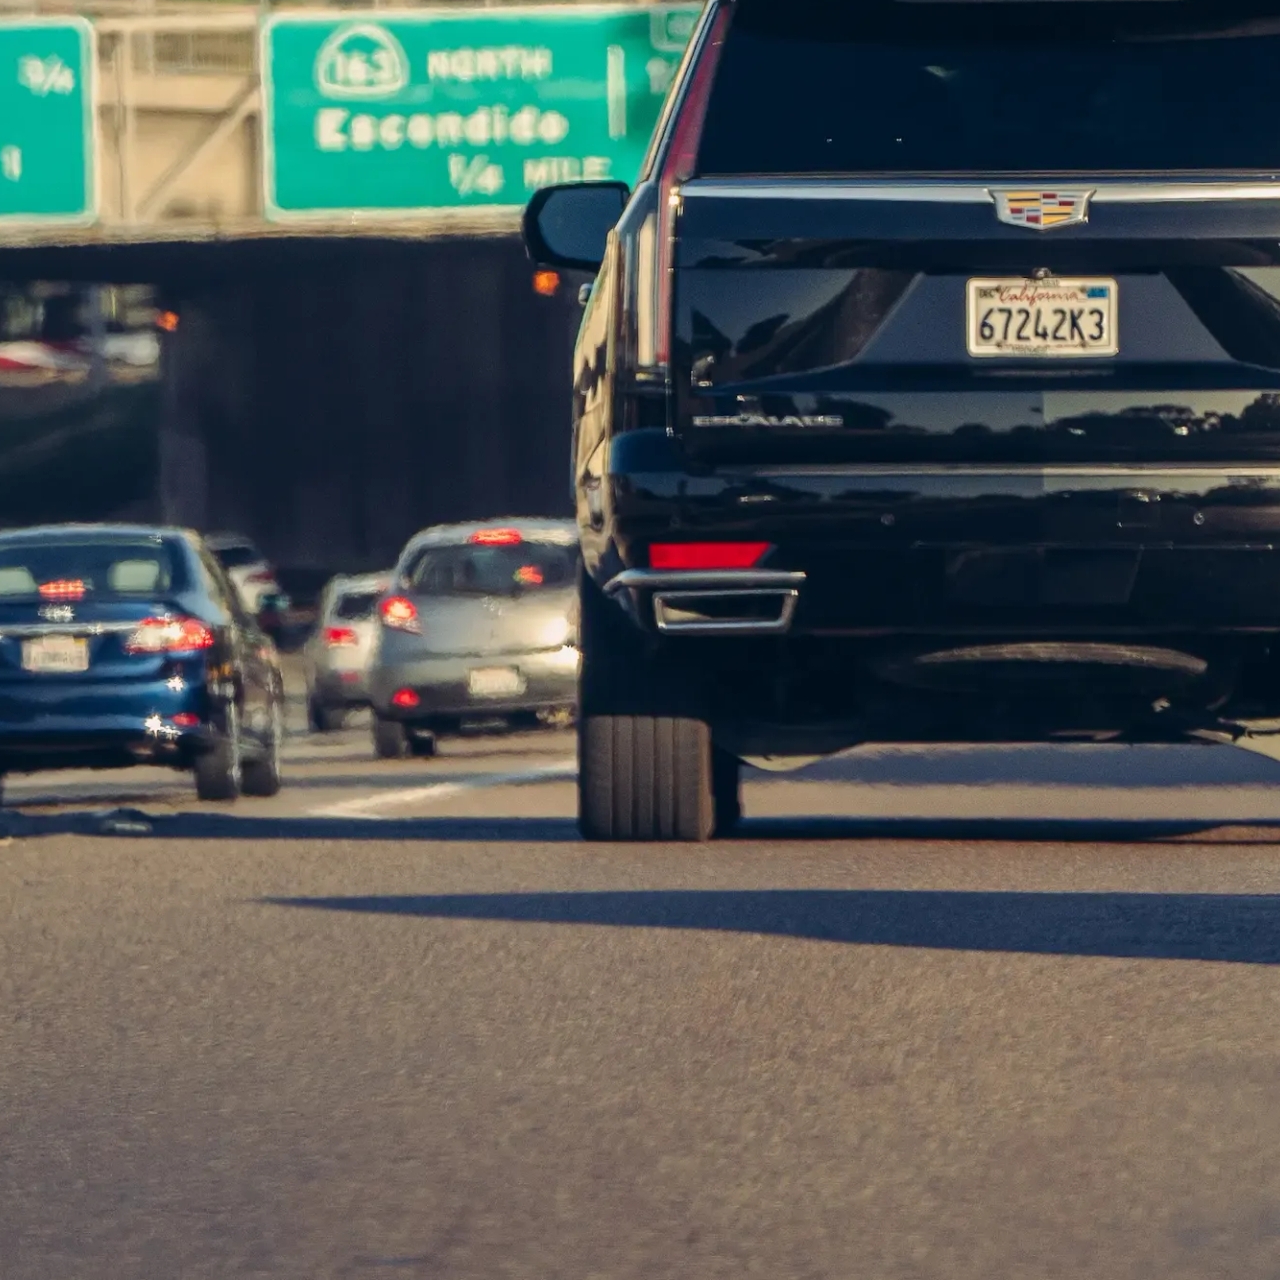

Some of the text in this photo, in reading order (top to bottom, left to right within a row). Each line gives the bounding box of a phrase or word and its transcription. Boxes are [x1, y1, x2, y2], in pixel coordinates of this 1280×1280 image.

[334, 44, 553, 87] 163 NORTH
[314, 104, 569, 152] Escondido
[997, 285, 1080, 307] California
[979, 307, 1106, 342] 67242K3
